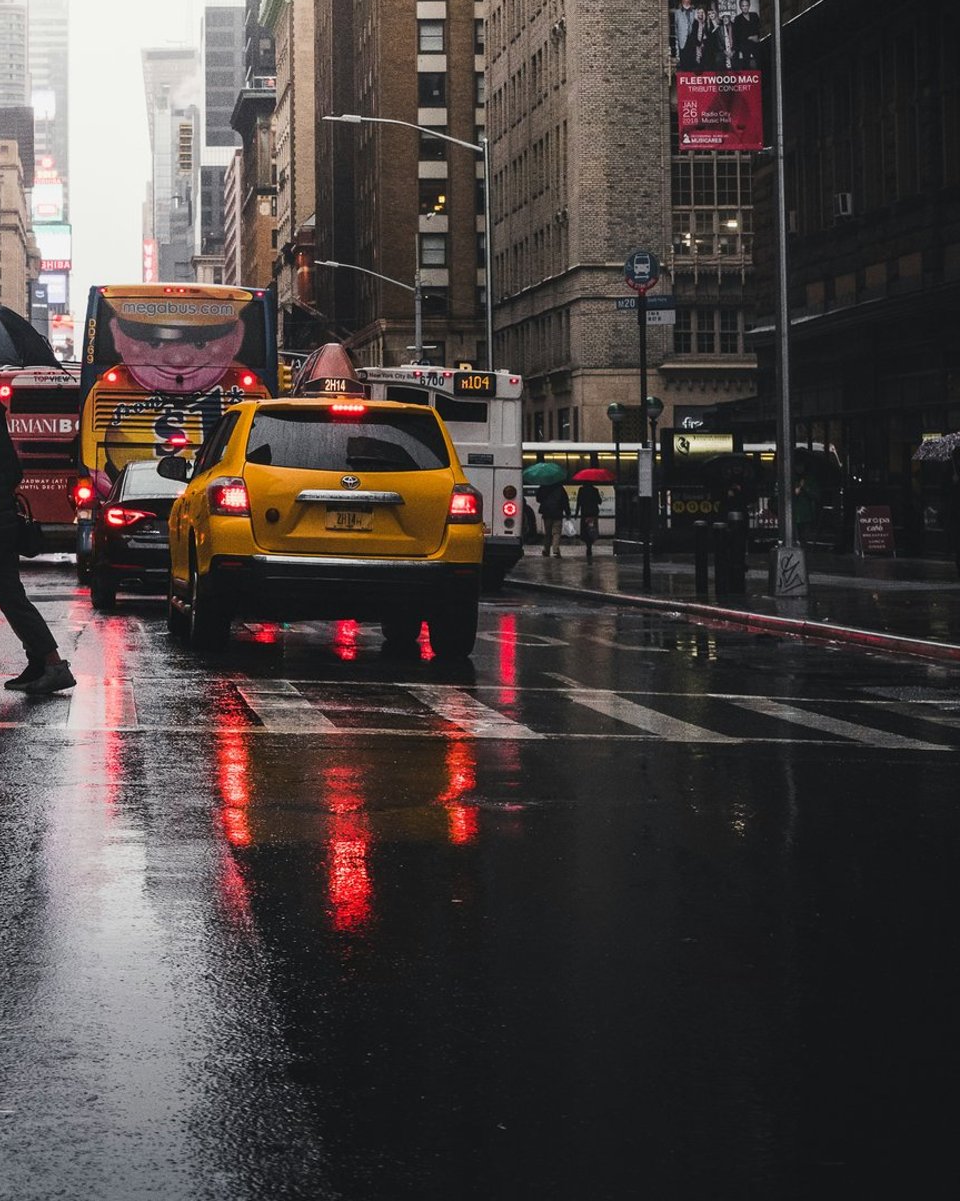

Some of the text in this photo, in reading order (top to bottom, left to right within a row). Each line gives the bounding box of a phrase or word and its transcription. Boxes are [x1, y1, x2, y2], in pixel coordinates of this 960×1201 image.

[680, 75, 759, 85] FLEETWOOD MAC
[682, 101, 697, 109] JAN
[682, 108, 697, 118] 26
[123, 301, 236, 317] megabus.com
[86, 318, 96, 364] DD769
[325, 379, 346, 392] 2H14
[420, 376, 445, 386] 6700
[461, 376, 490, 390] M104
